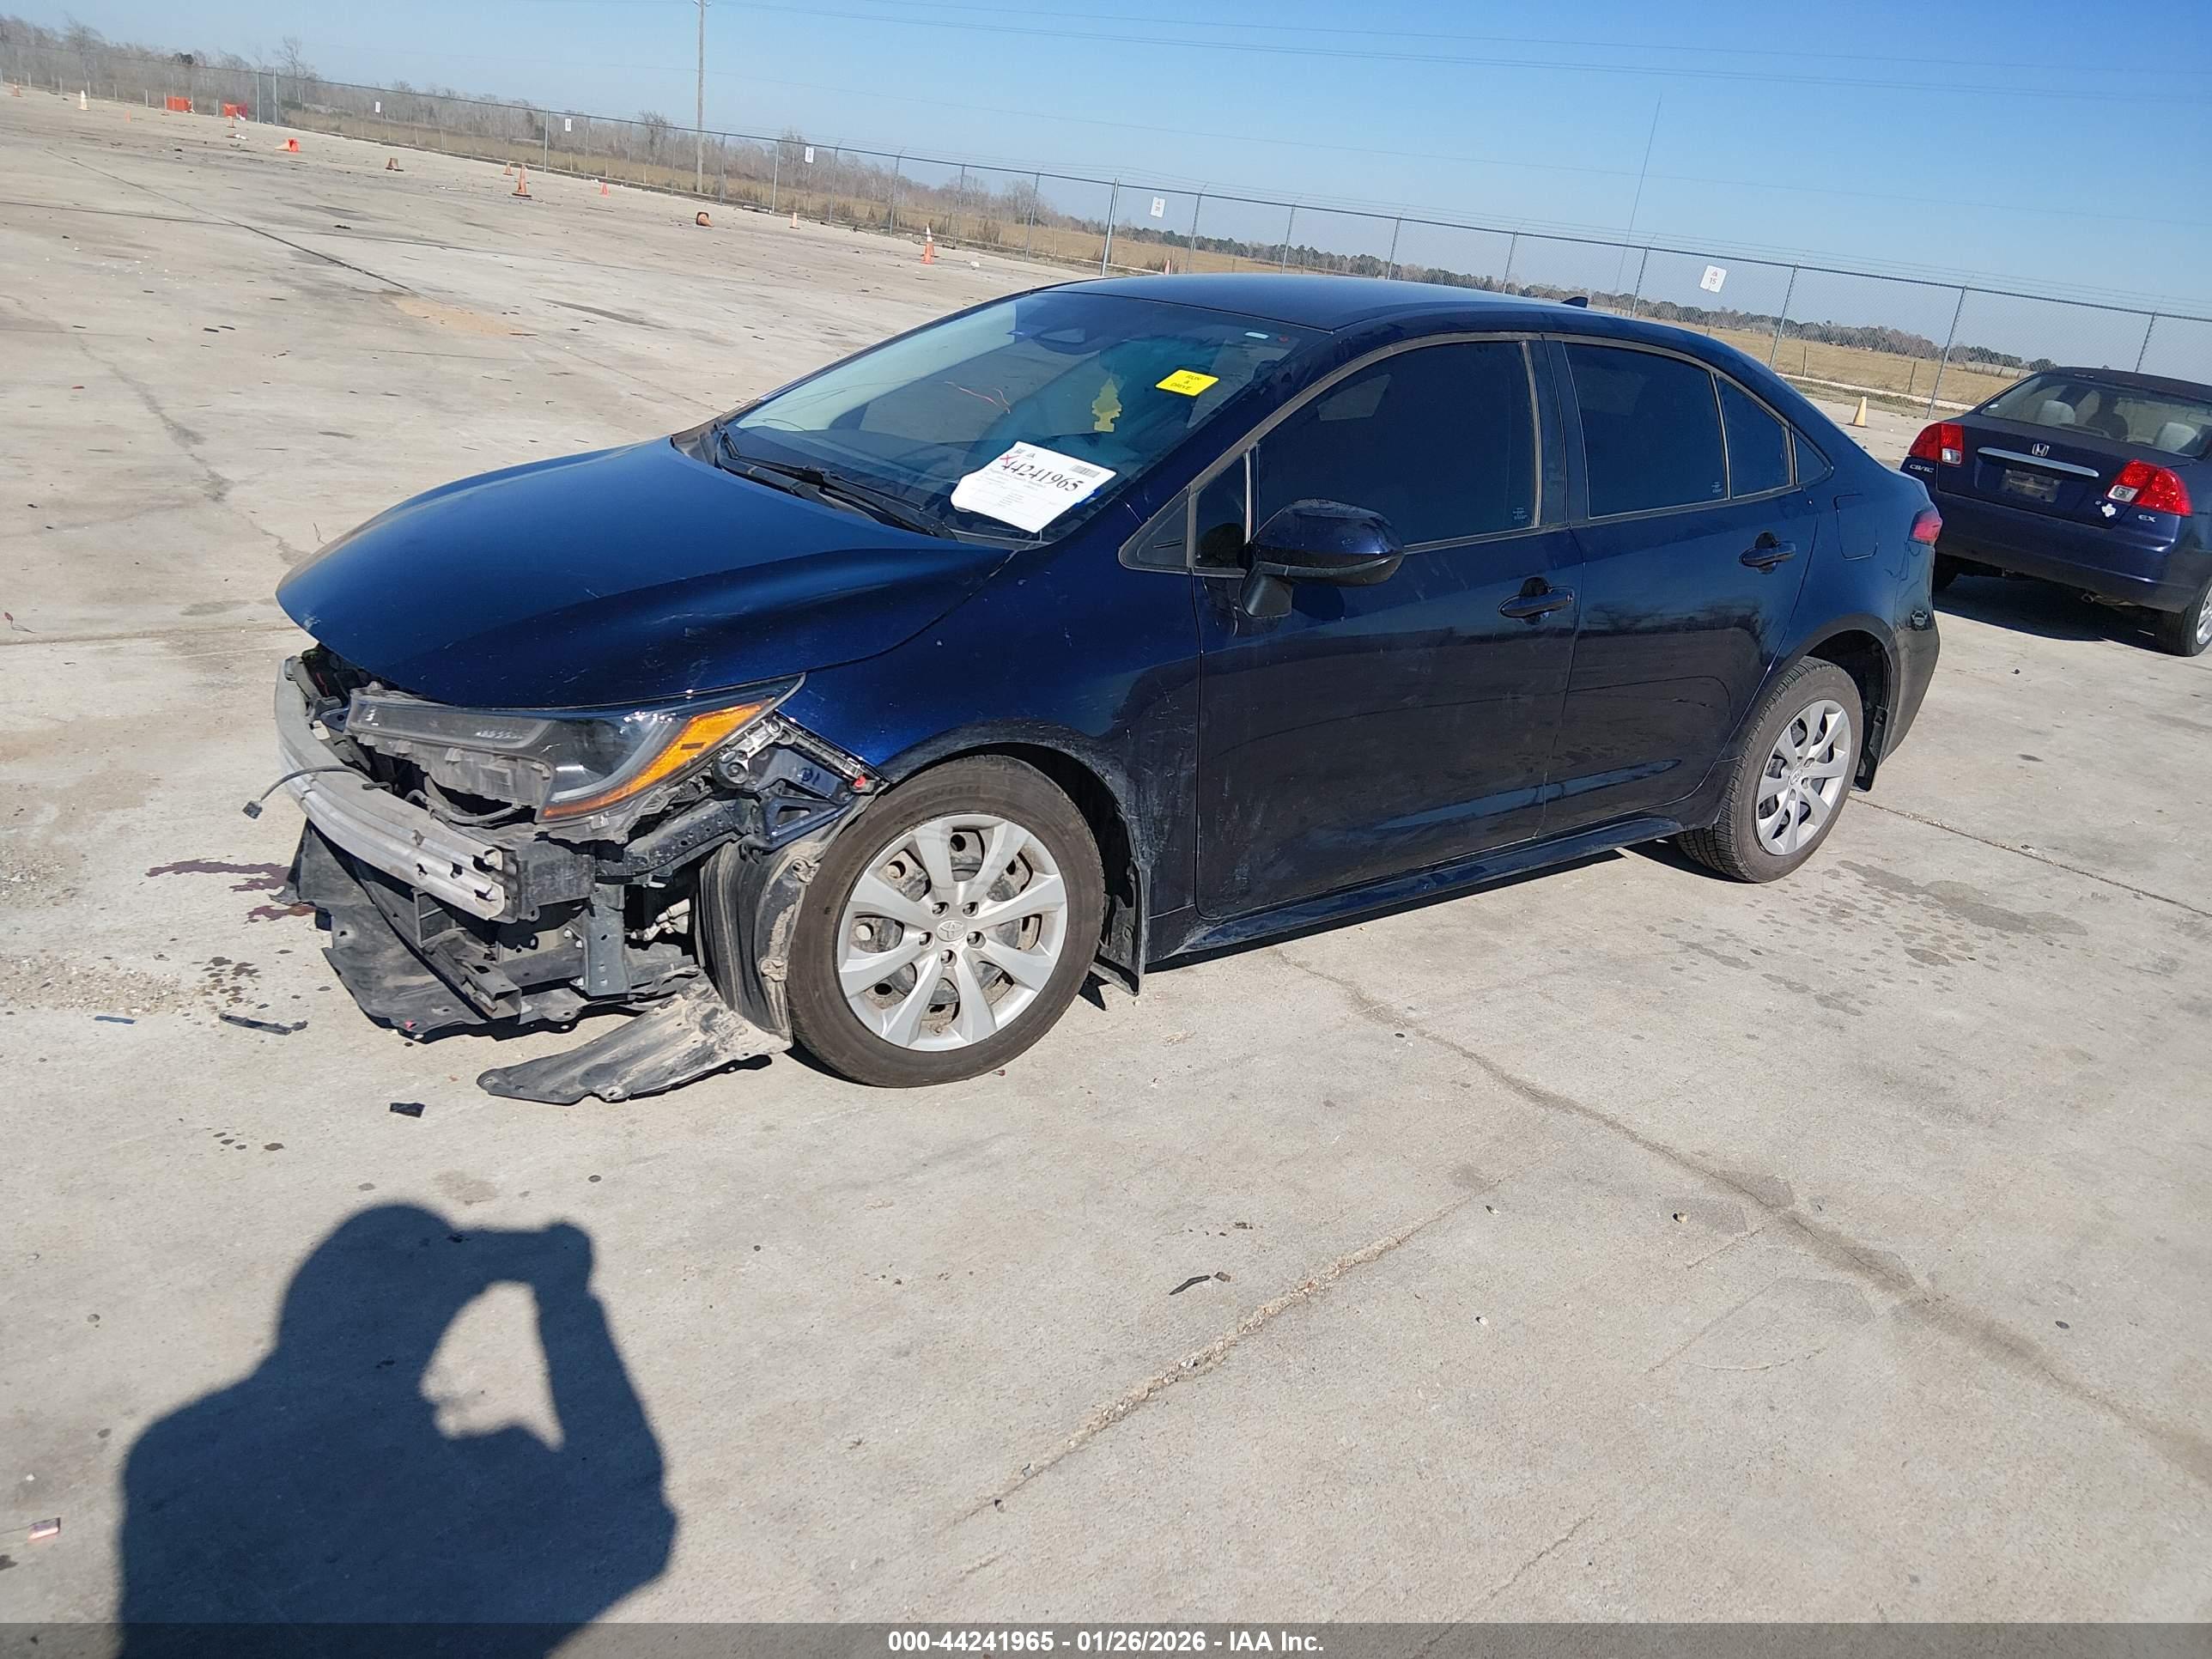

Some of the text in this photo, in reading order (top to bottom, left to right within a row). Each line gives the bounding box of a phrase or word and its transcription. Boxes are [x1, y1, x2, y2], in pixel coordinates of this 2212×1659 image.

[1909, 464, 1935, 473] CIVIC
[1000, 460, 1085, 492] 44241965
[2137, 514, 2157, 523] EX
